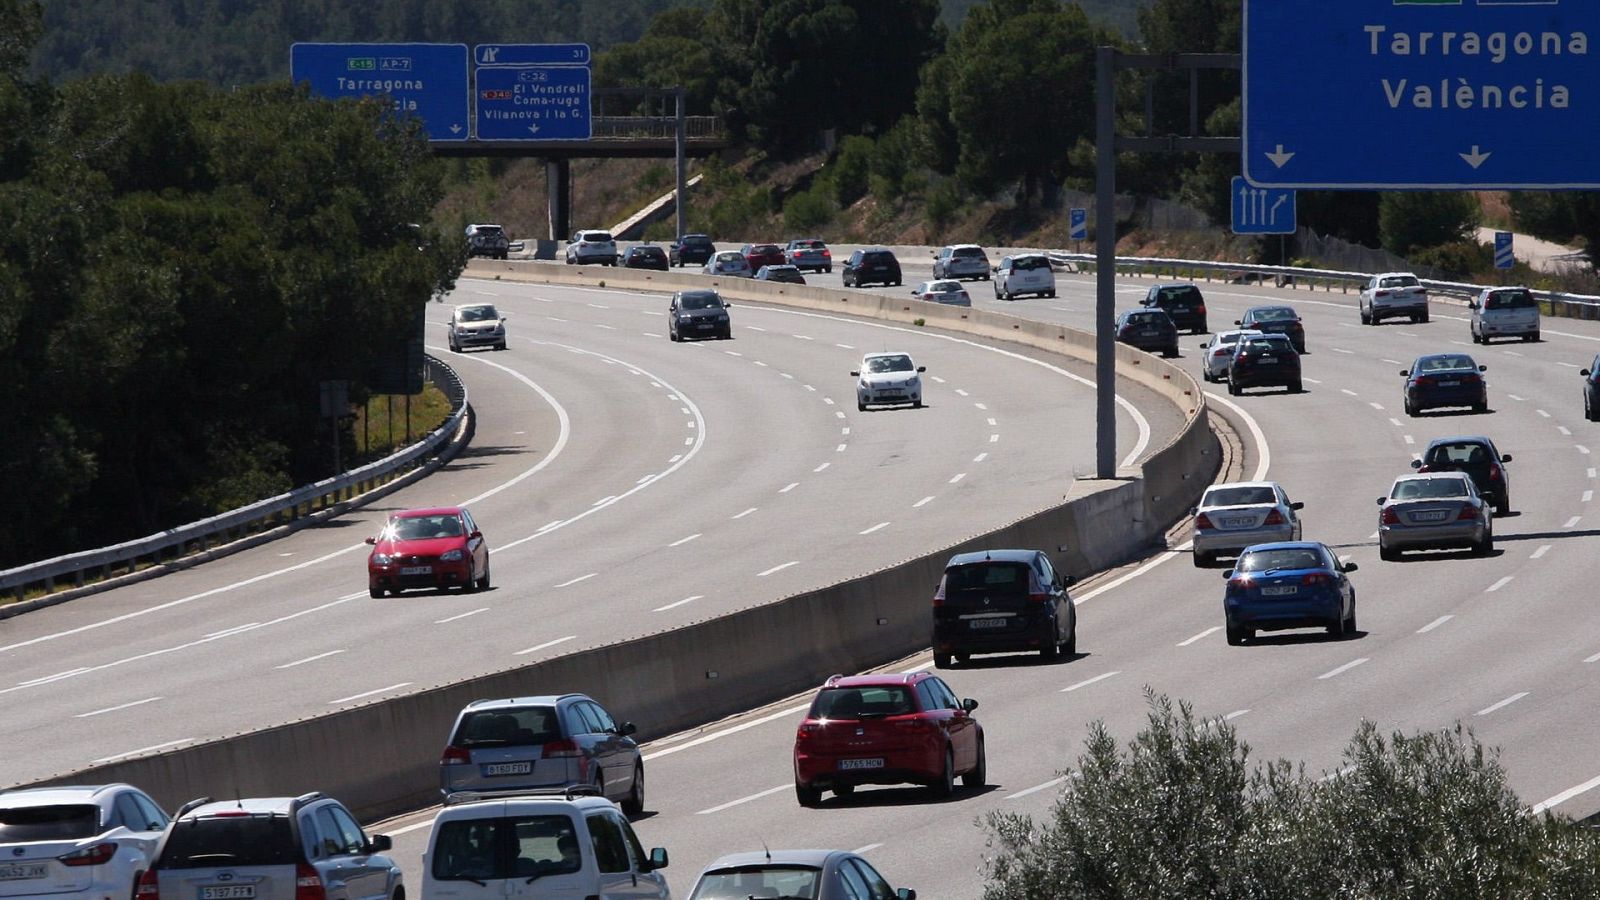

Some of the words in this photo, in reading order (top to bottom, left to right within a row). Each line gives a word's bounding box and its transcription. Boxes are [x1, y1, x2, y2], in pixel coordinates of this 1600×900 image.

[1364, 25, 1588, 63] Tarragona
[572, 49, 584, 58] 31
[349, 60, 373, 68] E-15
[382, 60, 409, 68] AP-7
[520, 72, 546, 80] C-32
[337, 77, 423, 92] Tarragona
[513, 84, 525, 93] El
[531, 84, 584, 93] Vendrell
[1381, 78, 1569, 108] València
[513, 95, 580, 107] Coma-ruga
[484, 109, 540, 119] Vilanova
[555, 109, 566, 119] la
[571, 109, 583, 119] G.
